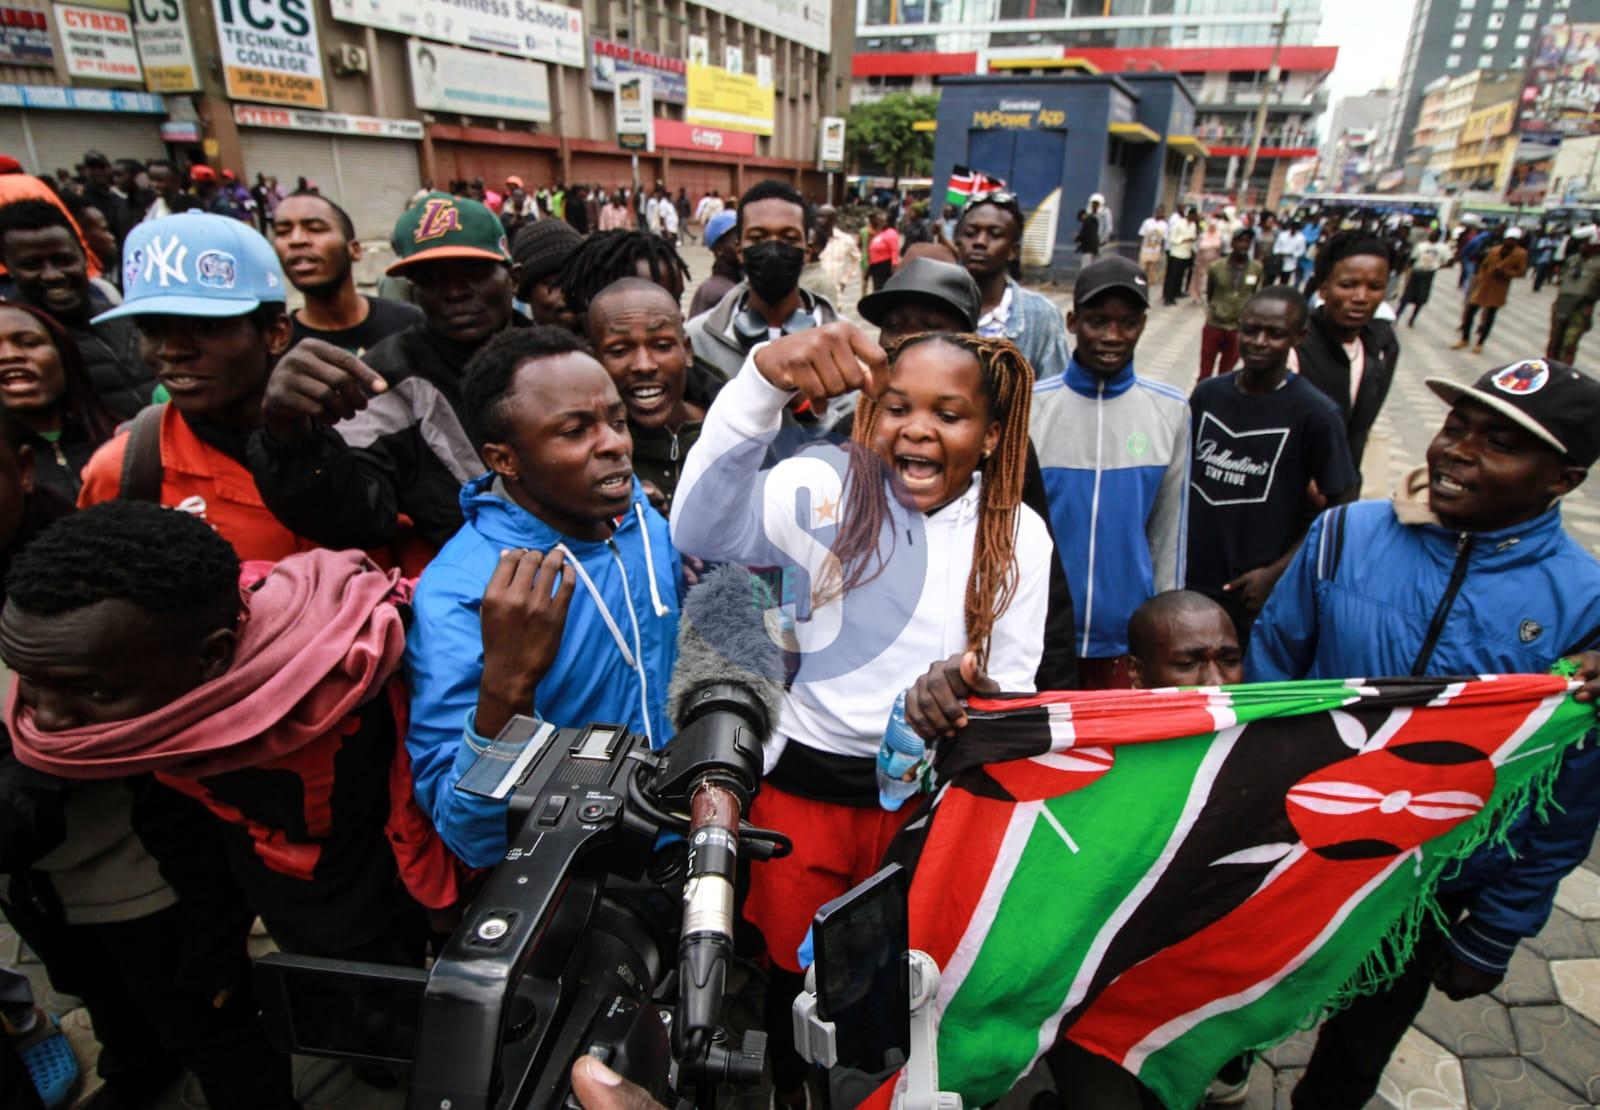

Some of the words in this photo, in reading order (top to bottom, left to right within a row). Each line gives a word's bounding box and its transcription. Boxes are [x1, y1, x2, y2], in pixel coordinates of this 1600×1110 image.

[64, 9, 128, 33] CYBER
[219, 0, 310, 37] ICS
[515, 0, 569, 30] School
[224, 28, 316, 57] TECHNICAL
[236, 48, 308, 73] COLLEGE
[269, 74, 315, 91] FLOOR
[973, 110, 1031, 130] MyPower
[1037, 109, 1066, 127] App
[413, 198, 463, 244] LA
[144, 234, 189, 287] NY
[1196, 439, 1269, 476] Ballantine's
[1205, 464, 1223, 481] STAY
[1223, 471, 1246, 486] TRUE
